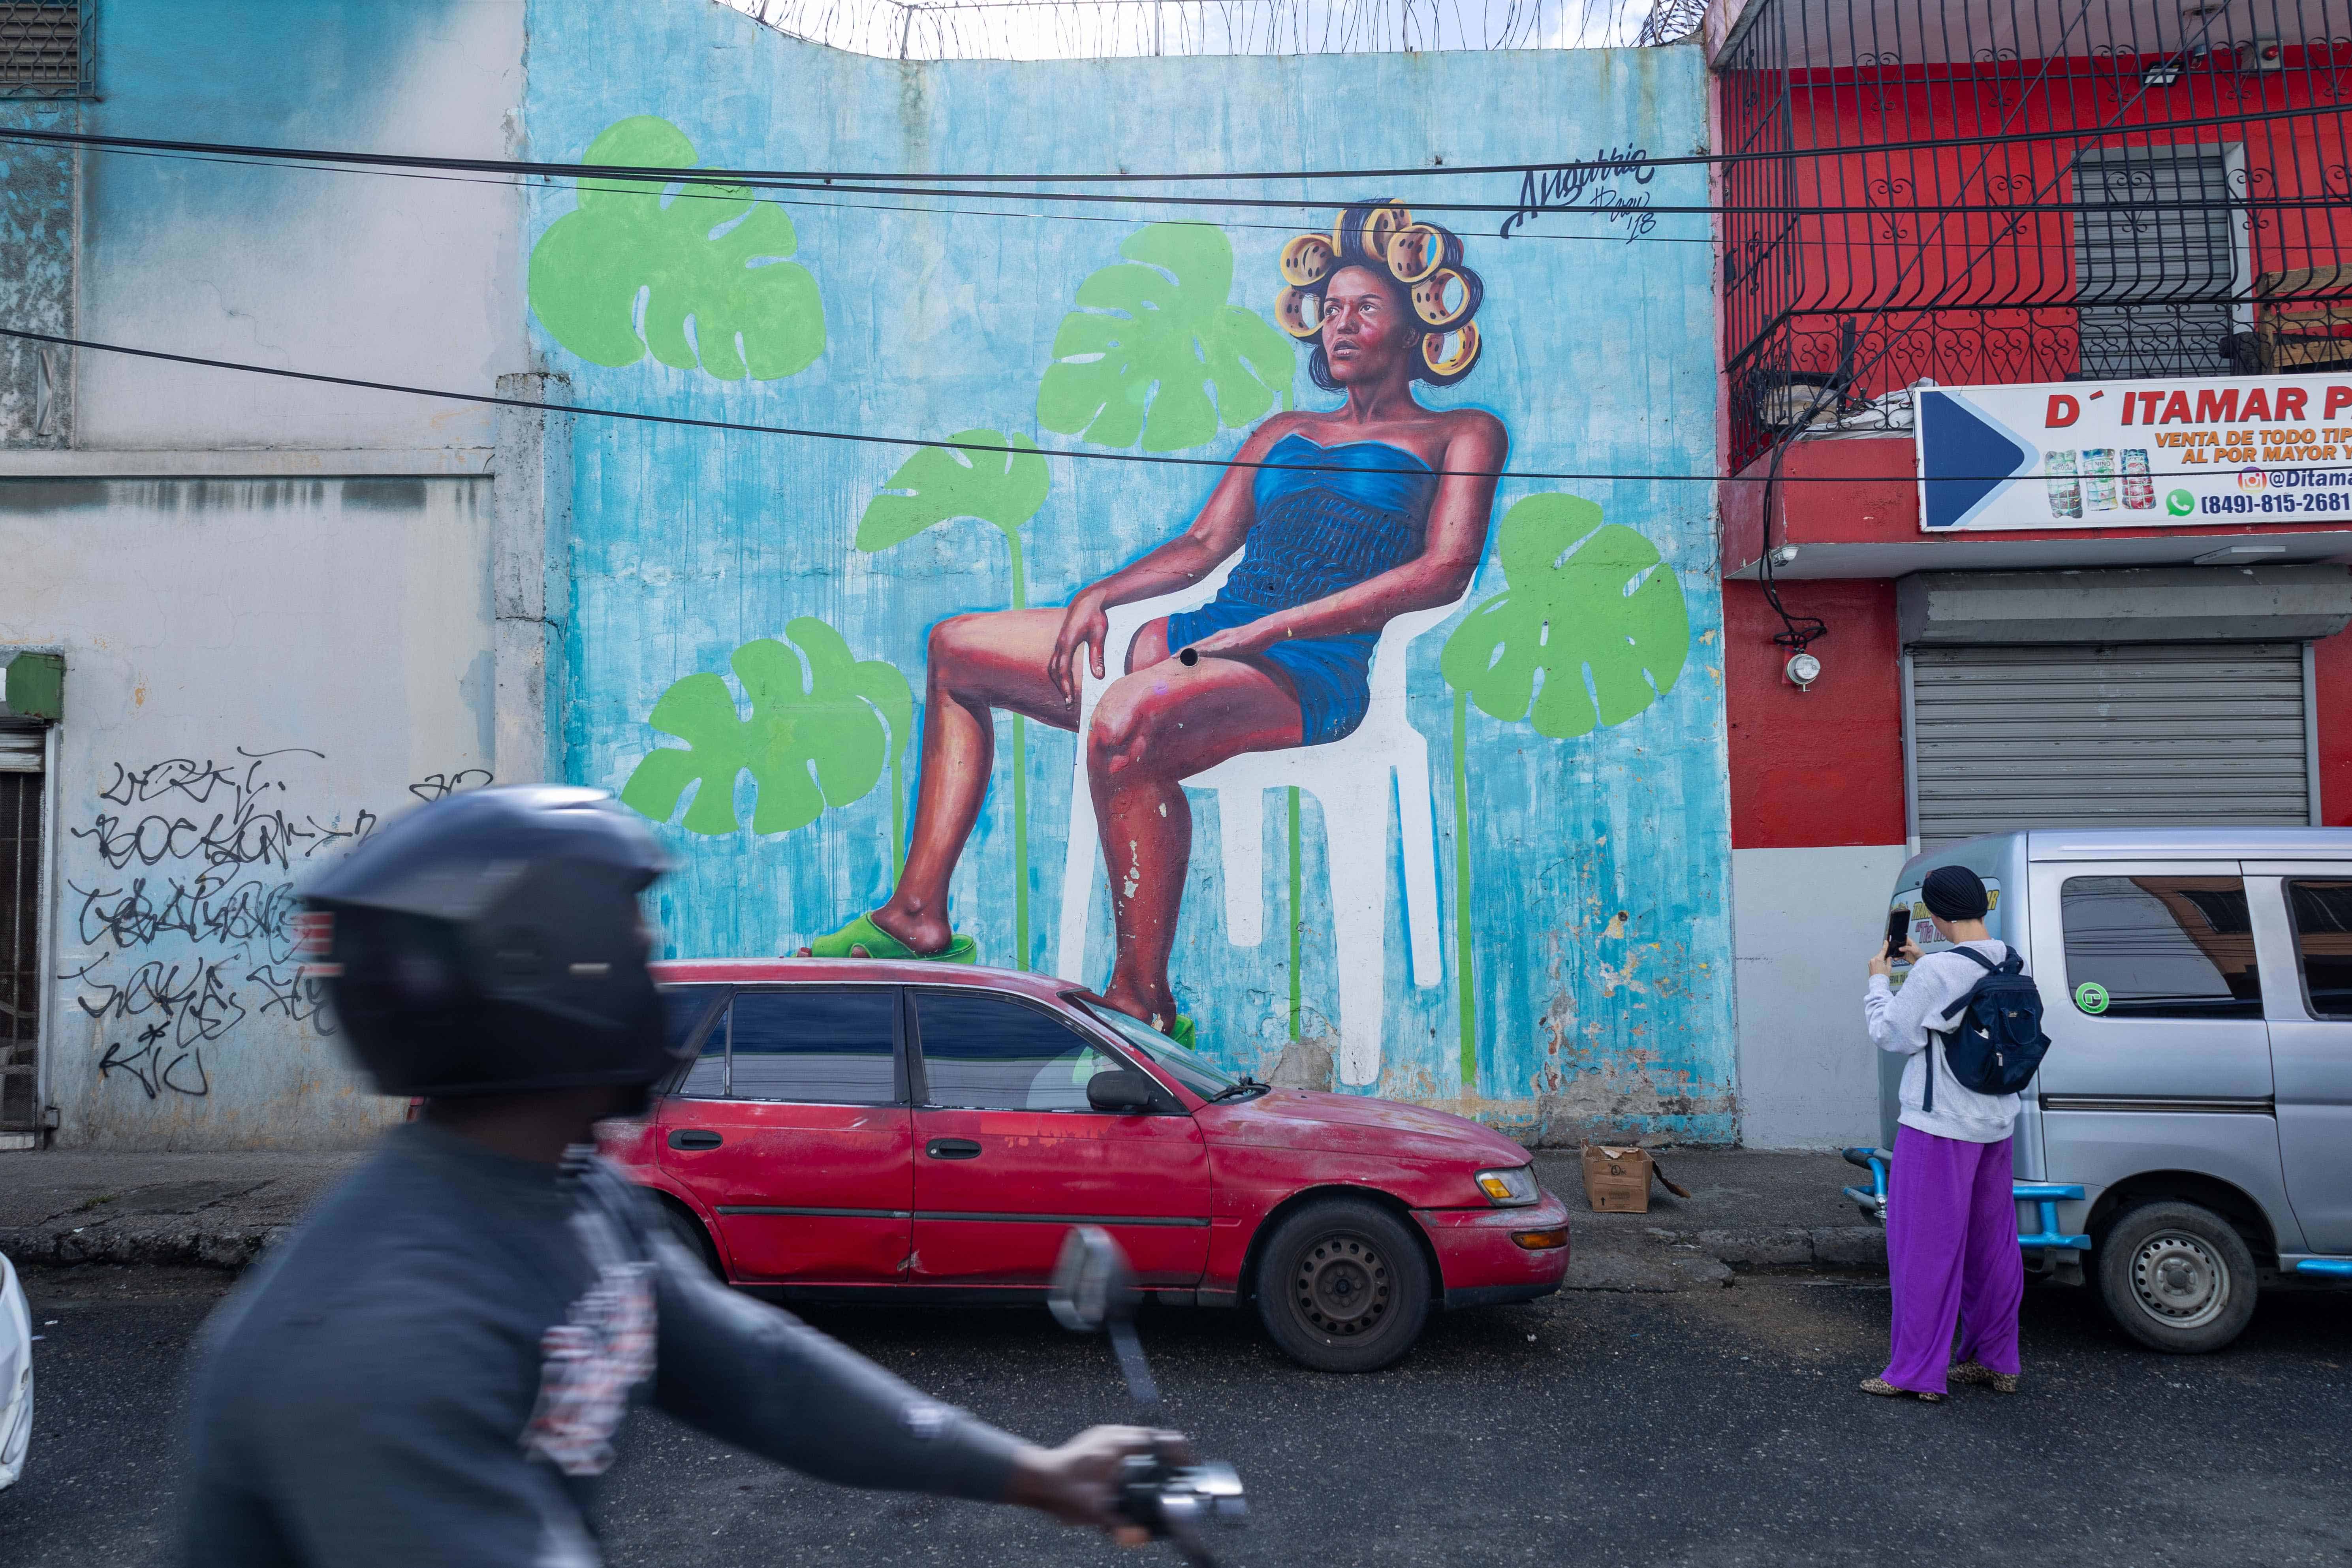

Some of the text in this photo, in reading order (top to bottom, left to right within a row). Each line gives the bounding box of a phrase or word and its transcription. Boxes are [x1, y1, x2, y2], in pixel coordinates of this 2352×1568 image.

[2121, 387, 2308, 426] ITAMAR
[2323, 386, 2352, 420] P
[2155, 431, 2220, 447] VENTA
[2226, 430, 2254, 446] DE
[2259, 428, 2316, 445] TODO
[2181, 444, 2352, 464] AL POR MAYOR Y
[2201, 493, 2350, 514] (849)-815-2681
